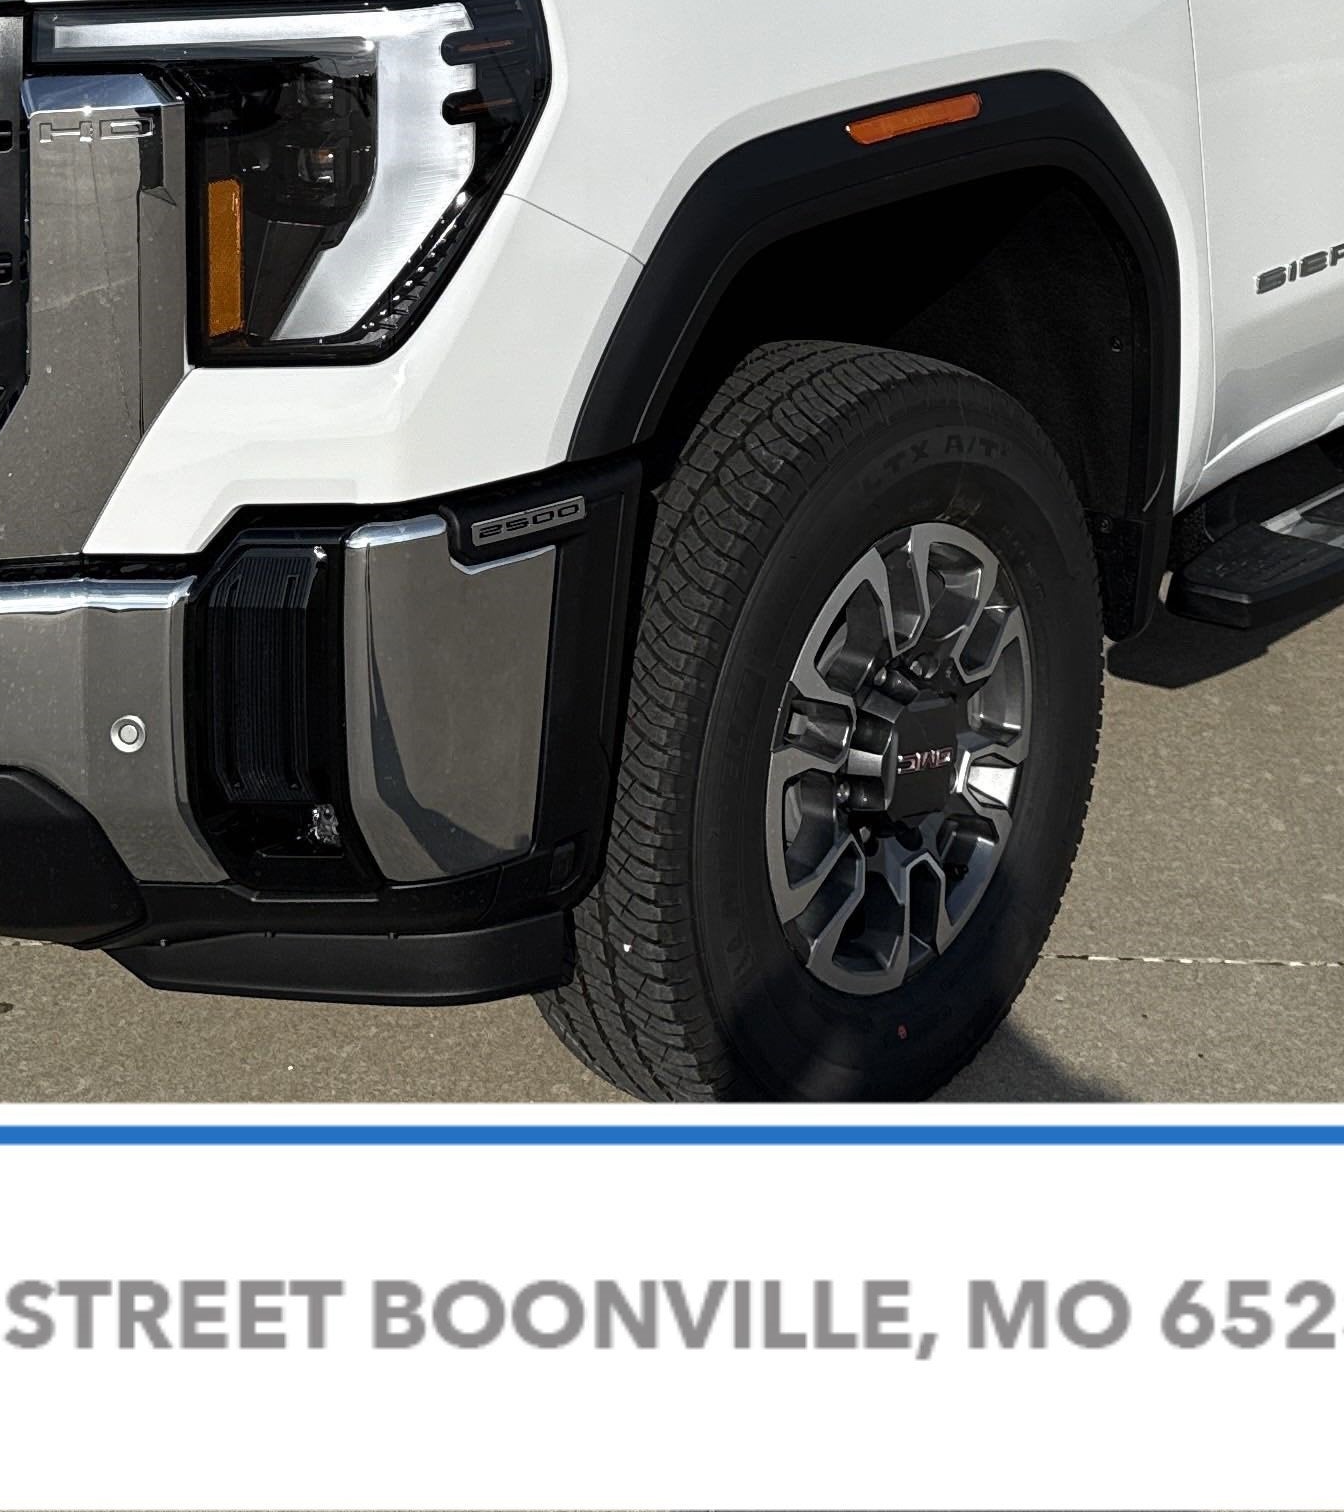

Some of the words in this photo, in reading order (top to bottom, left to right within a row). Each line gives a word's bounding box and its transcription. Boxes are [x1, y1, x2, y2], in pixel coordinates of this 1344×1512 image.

[39, 117, 155, 144] HD
[478, 503, 580, 539] 2500
[897, 746, 953, 775] GMC
